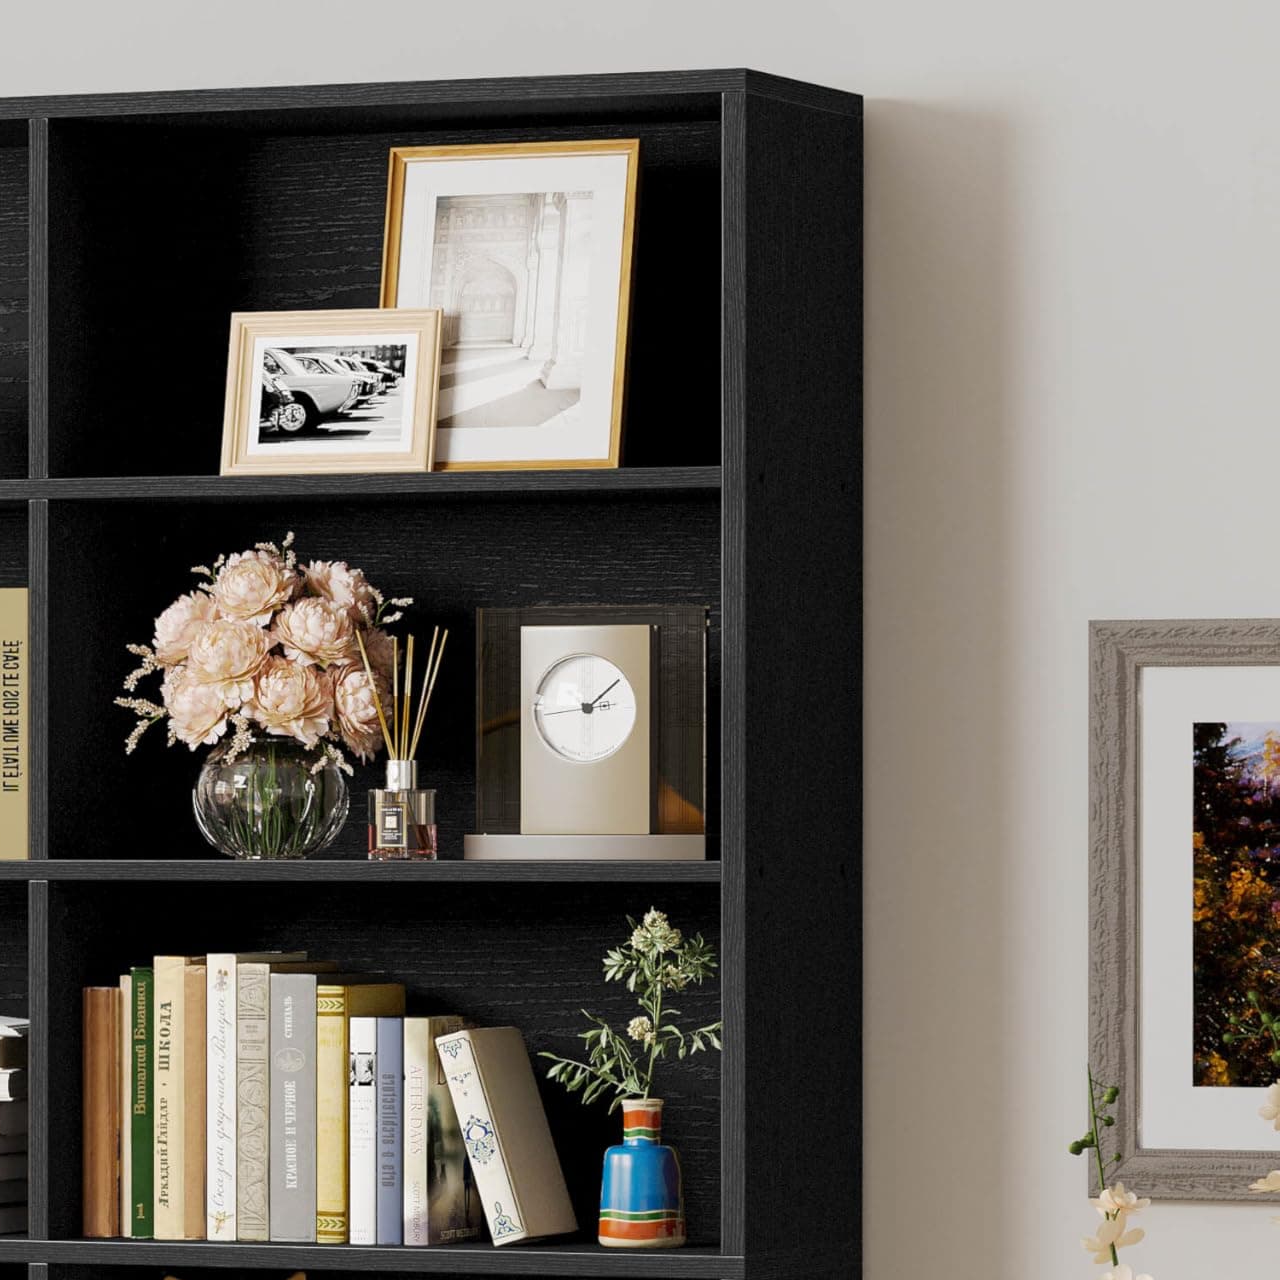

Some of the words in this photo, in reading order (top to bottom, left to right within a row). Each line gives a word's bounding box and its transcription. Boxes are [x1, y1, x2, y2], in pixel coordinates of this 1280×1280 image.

[133, 981, 147, 1041] Бианки
[158, 1000, 173, 1072] ШКОЛА
[133, 1043, 147, 1116] Виталий
[284, 1080, 297, 1124] ЧЕРНОЕ
[410, 1065, 423, 1112] AFTER
[410, 1117, 423, 1155] DAYS
[285, 1139, 298, 1189] КРАСНОЕ
